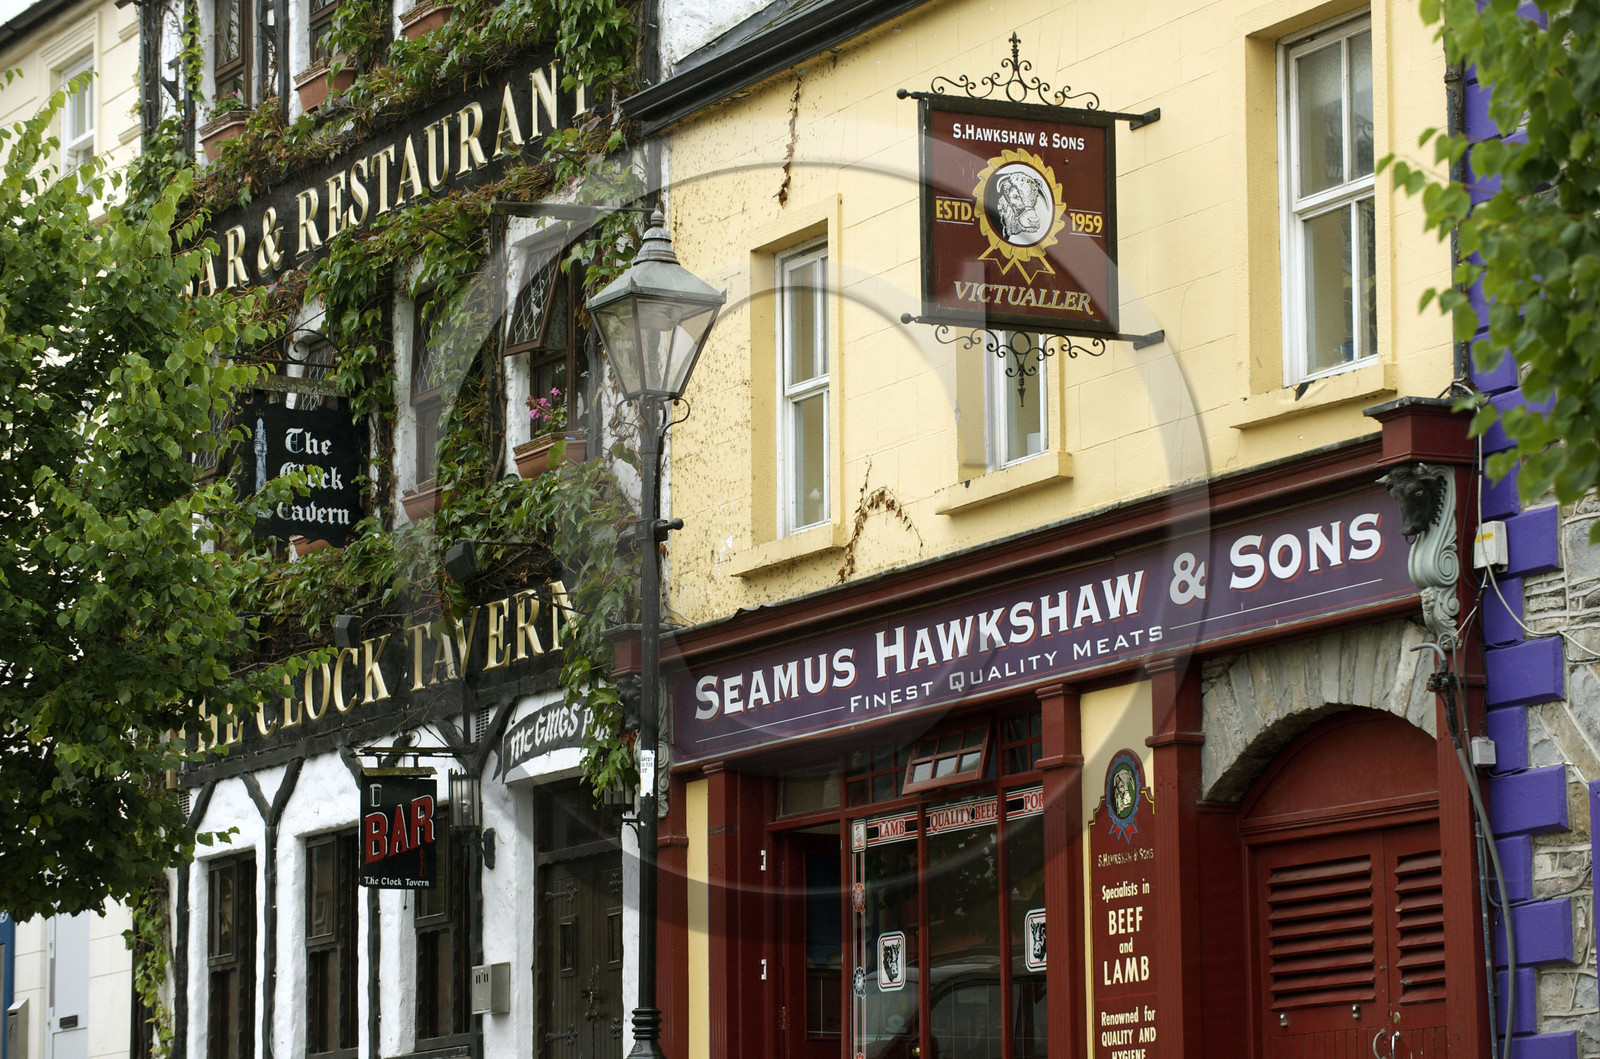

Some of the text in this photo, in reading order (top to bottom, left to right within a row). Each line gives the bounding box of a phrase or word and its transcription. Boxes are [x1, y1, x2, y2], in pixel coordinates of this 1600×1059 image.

[1038, 132, 1049, 148] &
[1052, 132, 1086, 151] SONS
[935, 199, 976, 222] ESTD.
[1069, 211, 1103, 234] 1959
[178, 225, 250, 297] AR
[257, 206, 285, 278] &
[953, 280, 1094, 315] VICTUALLER
[284, 427, 333, 456] The
[276, 500, 351, 525] Tavern
[694, 512, 1384, 721] SEAMUS HAWKSHAW & SONS
[850, 624, 1164, 713] FINEST QUALITY MEATS
[256, 633, 392, 738] CLOCK
[363, 794, 436, 865] BAR
[877, 820, 905, 838] LAMB
[930, 801, 998, 832] QUALITY BEEF
[363, 875, 430, 887] The Clock Tavern
[1101, 877, 1150, 903] Specialists in
[1108, 905, 1143, 936] BEEF
[1119, 936, 1134, 954] and
[1103, 955, 1150, 986] LAMB
[1101, 1004, 1156, 1027] Renowned for
[1101, 1026, 1157, 1047] QUALITY AND
